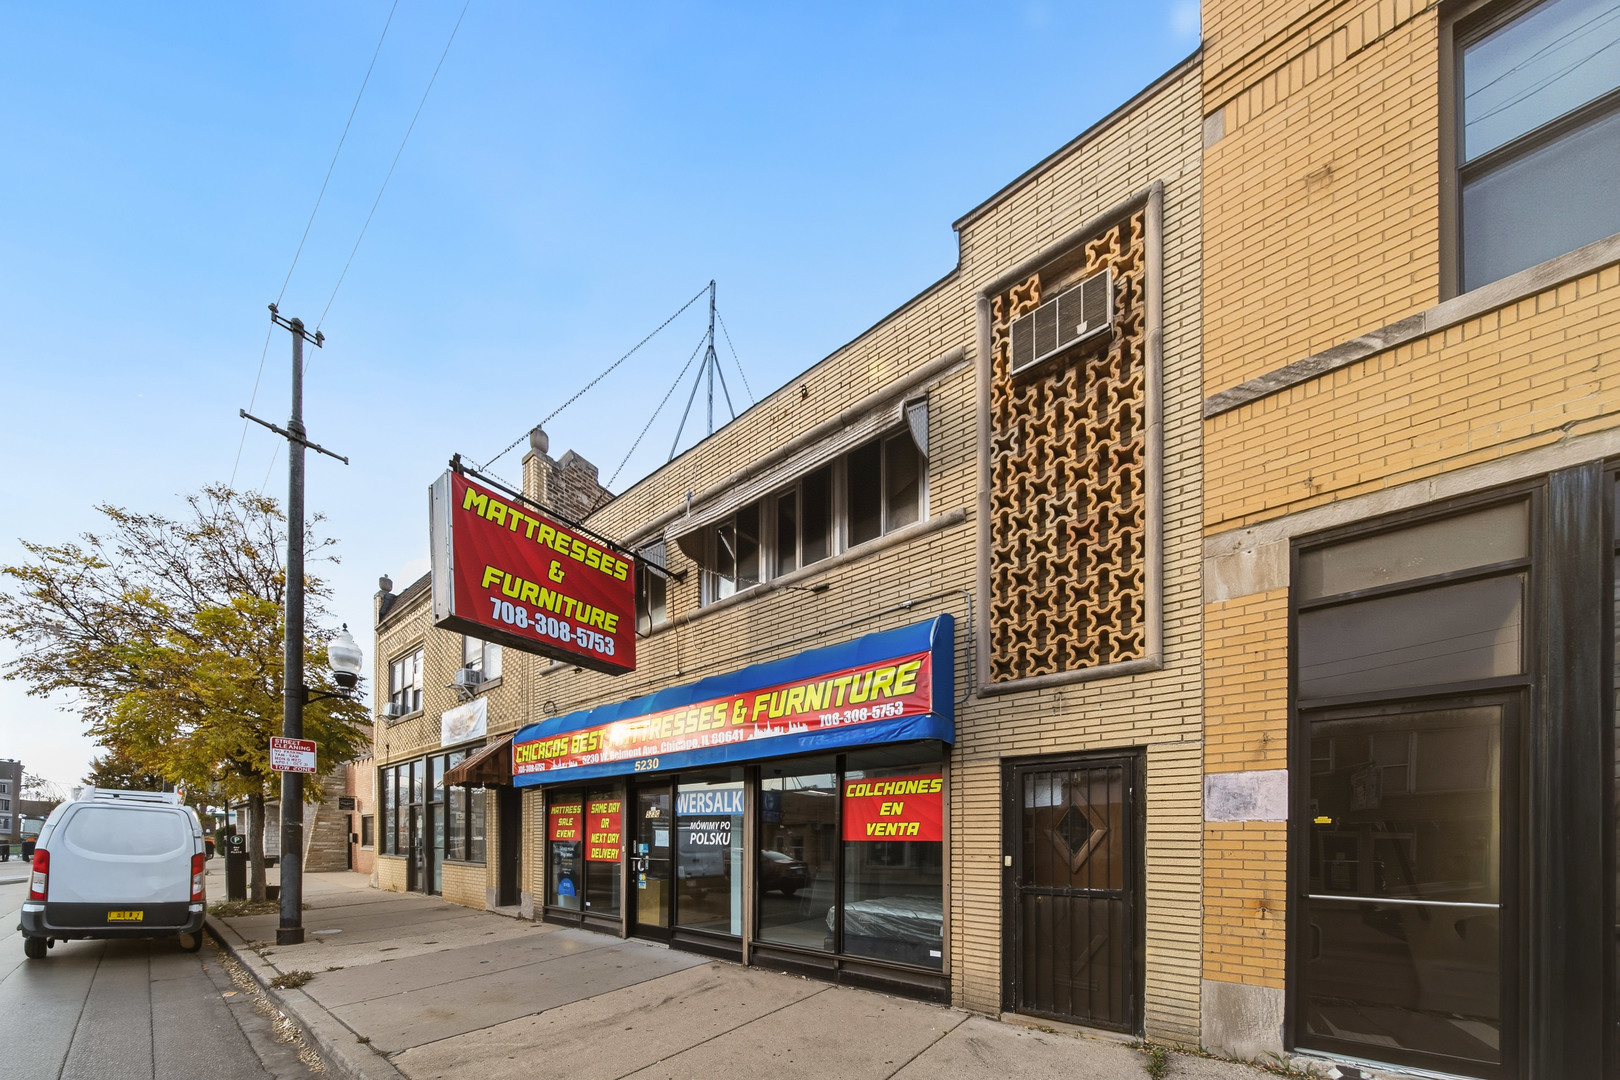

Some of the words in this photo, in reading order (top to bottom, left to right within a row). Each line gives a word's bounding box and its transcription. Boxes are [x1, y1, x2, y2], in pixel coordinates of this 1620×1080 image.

[462, 486, 629, 582] MATTRESSES
[548, 559, 565, 584] &
[481, 564, 619, 634] FURNITURE
[489, 597, 615, 656] 708-308-5753
[515, 741, 569, 763] CHICAGOS
[571, 729, 605, 754] BEST
[607, 703, 729, 747] TTRESSES
[731, 698, 748, 725] &
[751, 659, 922, 722] FURNITURE
[818, 701, 904, 727] 708-308-5753
[274, 743, 311, 751] CLEANING
[582, 753, 600, 764] 5230
[609, 748, 641, 760] Belmont
[634, 757, 659, 772] 5230
[846, 778, 943, 797] COLCHONES
[551, 805, 582, 814] MATTRESS
[591, 803, 607, 814] SAME
[608, 802, 621, 813] DAY
[879, 801, 904, 816] EN
[558, 817, 574, 826] SALE
[601, 818, 610, 829] OR
[689, 820, 720, 830] MÓWIMY
[720, 821, 731, 830] PO
[556, 829, 575, 838] EVENT
[866, 822, 920, 836] VENTA
[591, 833, 607, 844] NEXT
[607, 833, 620, 843] DAY
[689, 832, 731, 845] POLSKU
[591, 848, 619, 859] DELIVERY
